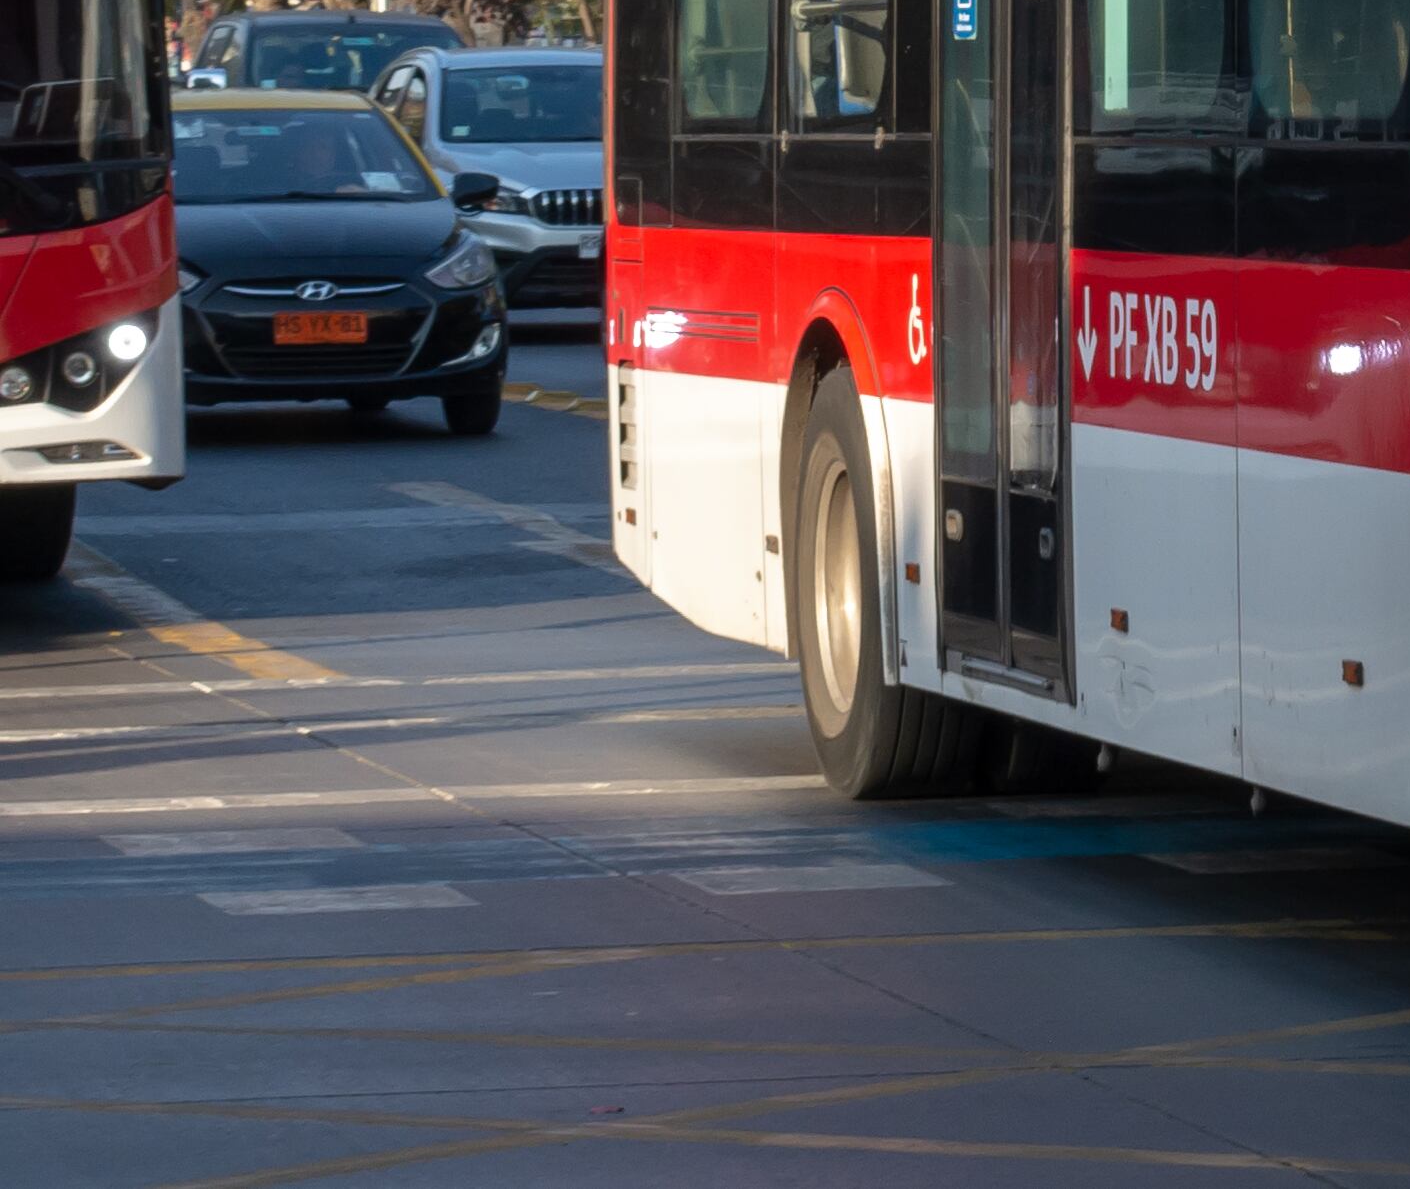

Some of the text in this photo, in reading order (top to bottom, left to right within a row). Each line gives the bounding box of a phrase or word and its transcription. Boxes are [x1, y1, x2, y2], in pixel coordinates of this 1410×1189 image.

[1109, 291, 1218, 392] PF XB 59
